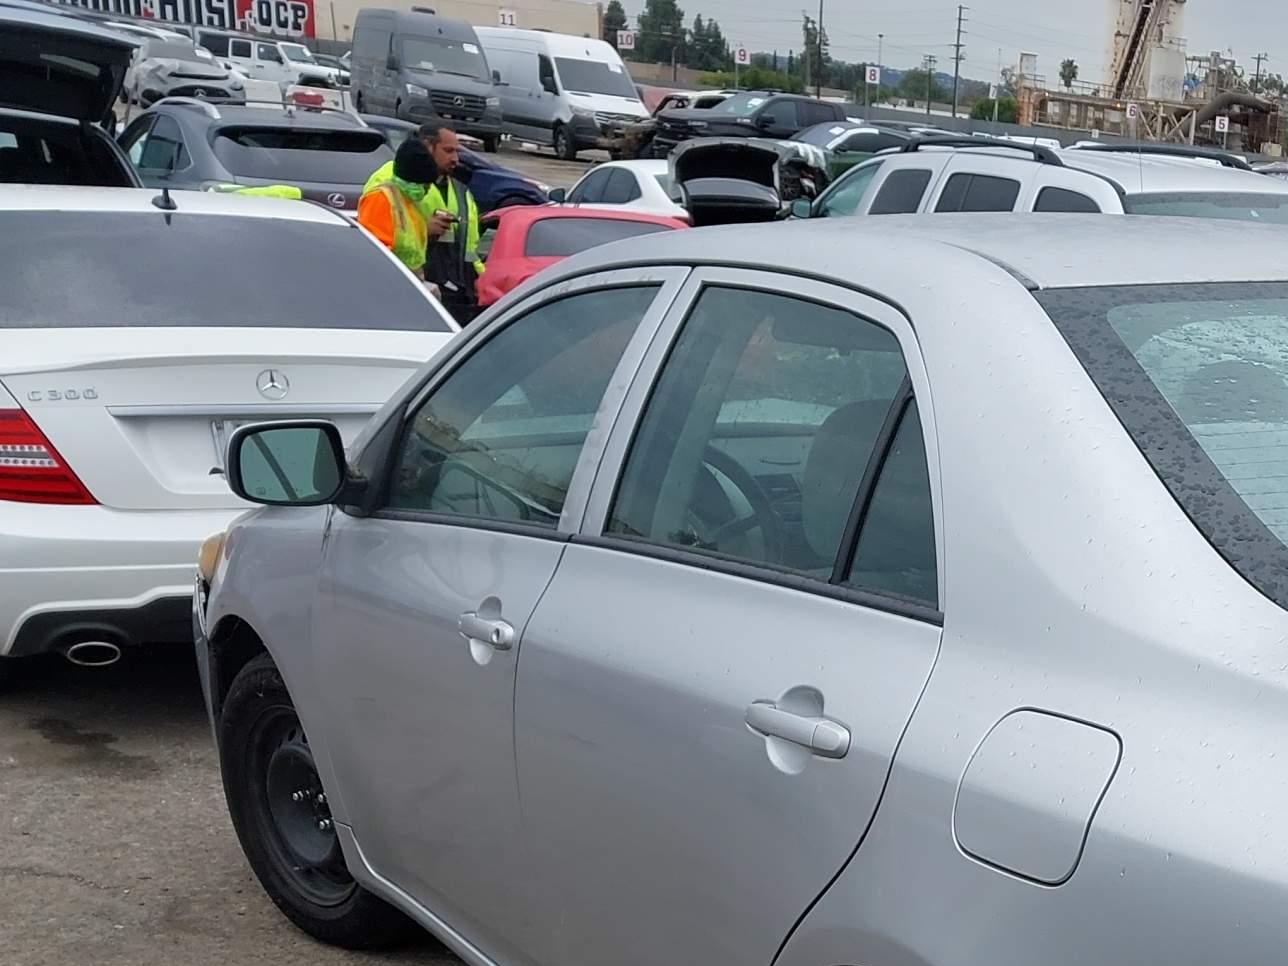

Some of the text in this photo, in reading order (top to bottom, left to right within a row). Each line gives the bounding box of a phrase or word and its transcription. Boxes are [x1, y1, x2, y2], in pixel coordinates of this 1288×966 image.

[501, 14, 515, 26] 11
[619, 34, 633, 46] 10
[738, 48, 747, 62] 9
[869, 69, 877, 81] 8
[1129, 105, 1137, 117] 6
[1218, 118, 1226, 130] 5
[27, 387, 99, 402] C 300
